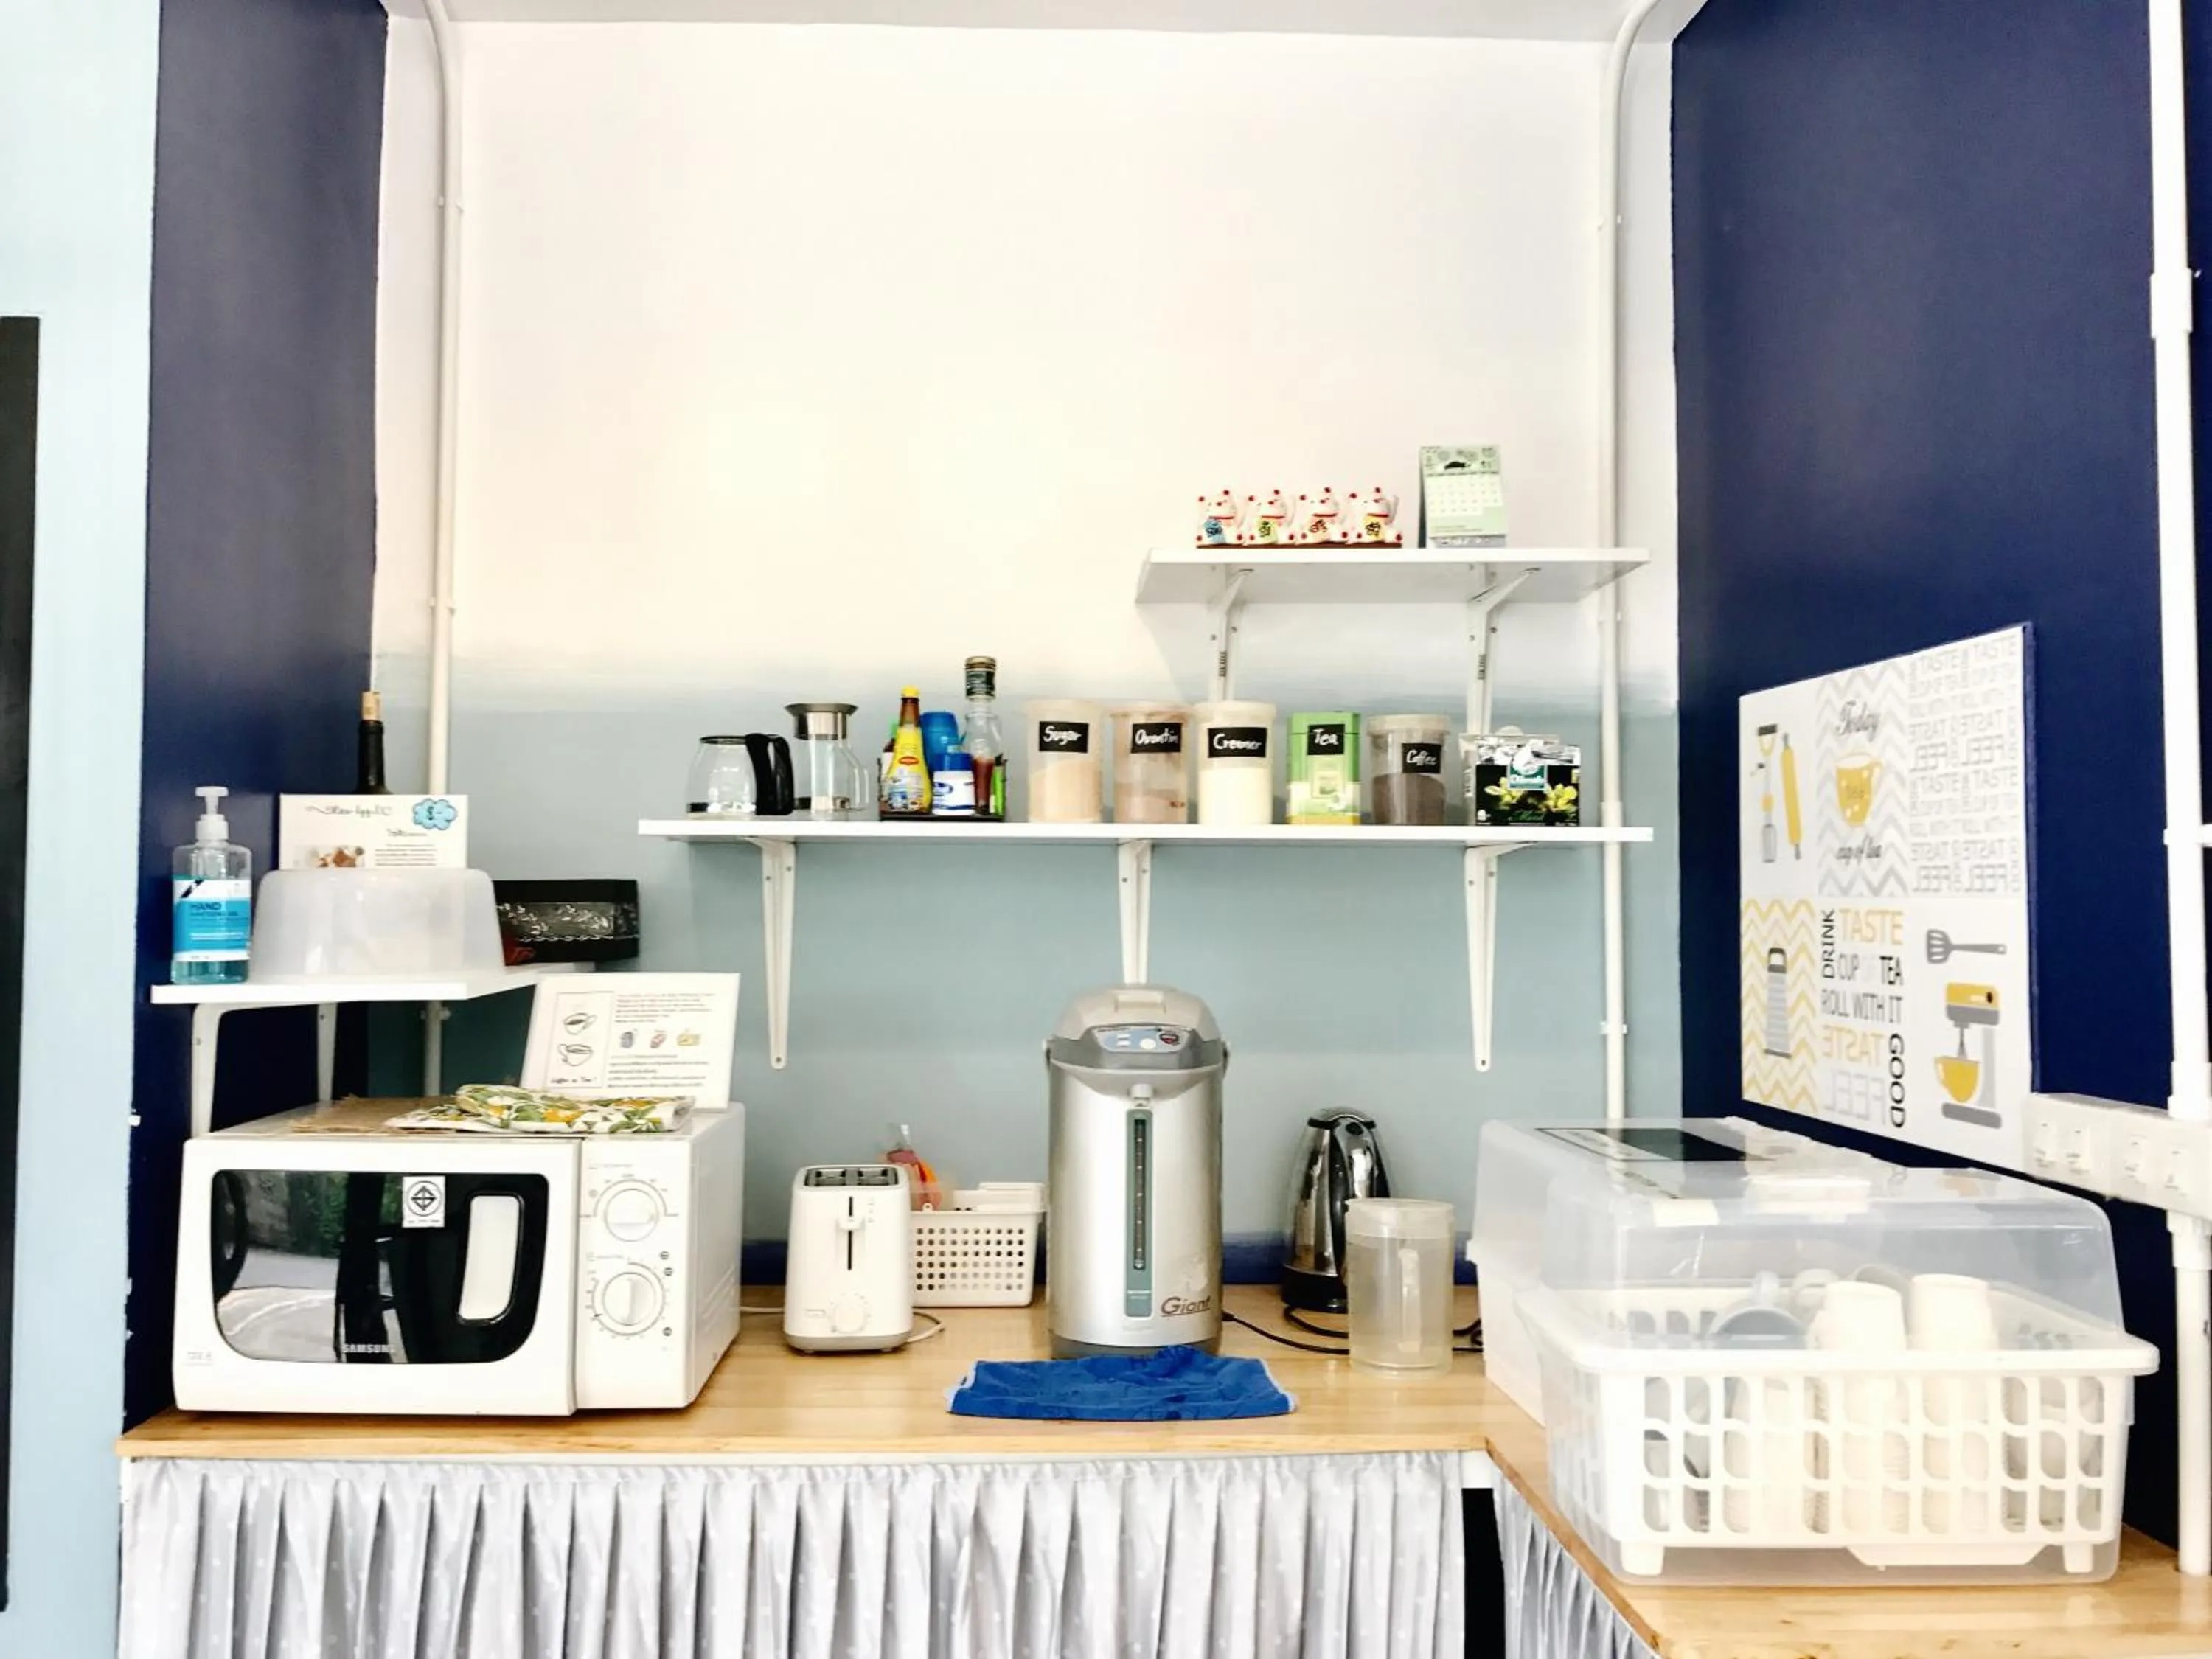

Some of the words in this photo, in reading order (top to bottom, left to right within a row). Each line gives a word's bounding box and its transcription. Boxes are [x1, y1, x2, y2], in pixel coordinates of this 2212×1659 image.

[1043, 725, 1082, 745] Sugar
[1312, 728, 1338, 745] Tea
[1405, 749, 1436, 765] Coffee
[1838, 908, 1904, 945] TASTE
[1822, 908, 1835, 979] DRINK
[1879, 954, 1904, 986] TEA
[1821, 989, 1849, 1017] ROLL
[1852, 992, 1885, 1022] WITH
[1888, 995, 1903, 1024] IT
[1888, 1032, 1905, 1128] GOOD
[1161, 1295, 1211, 1315] Giant
[341, 1343, 397, 1354] SAMSUNG
